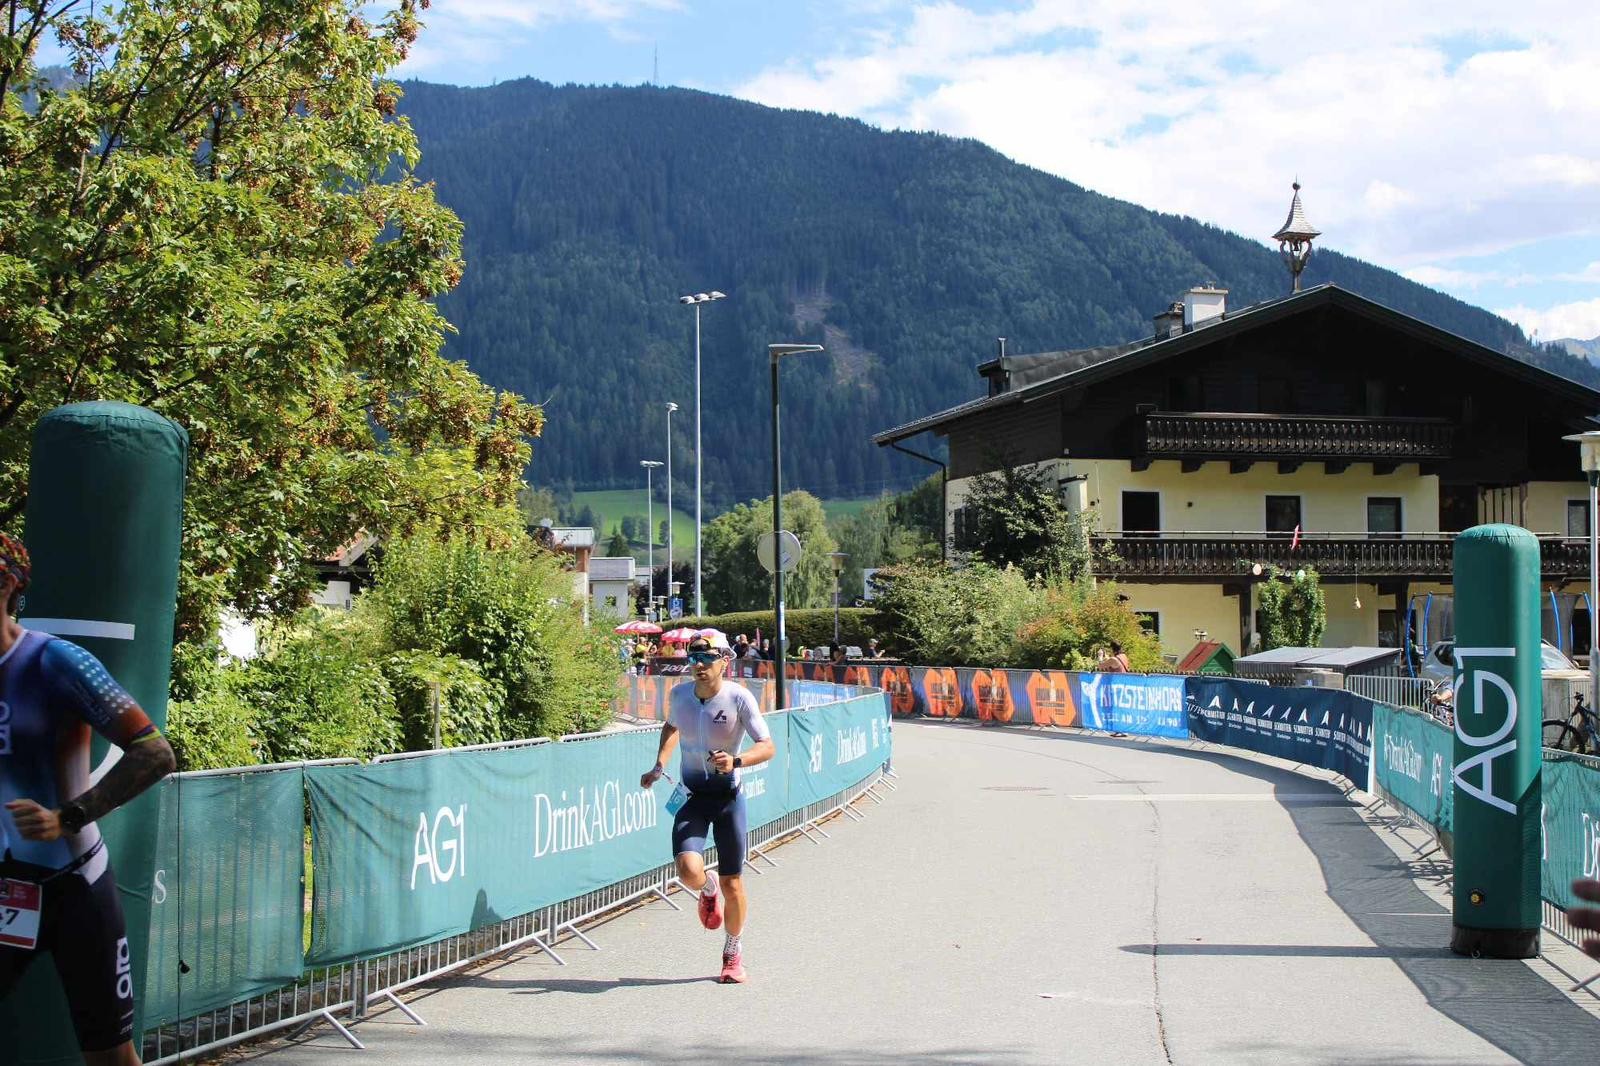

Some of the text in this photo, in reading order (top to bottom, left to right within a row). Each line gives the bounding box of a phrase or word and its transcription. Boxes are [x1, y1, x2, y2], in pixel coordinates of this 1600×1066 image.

[1100, 684, 1183, 712] KITZSTEINHORN
[1453, 646, 1517, 816] AG1
[410, 805, 465, 891] AG1
[533, 780, 657, 858] DrinkAG1.com
